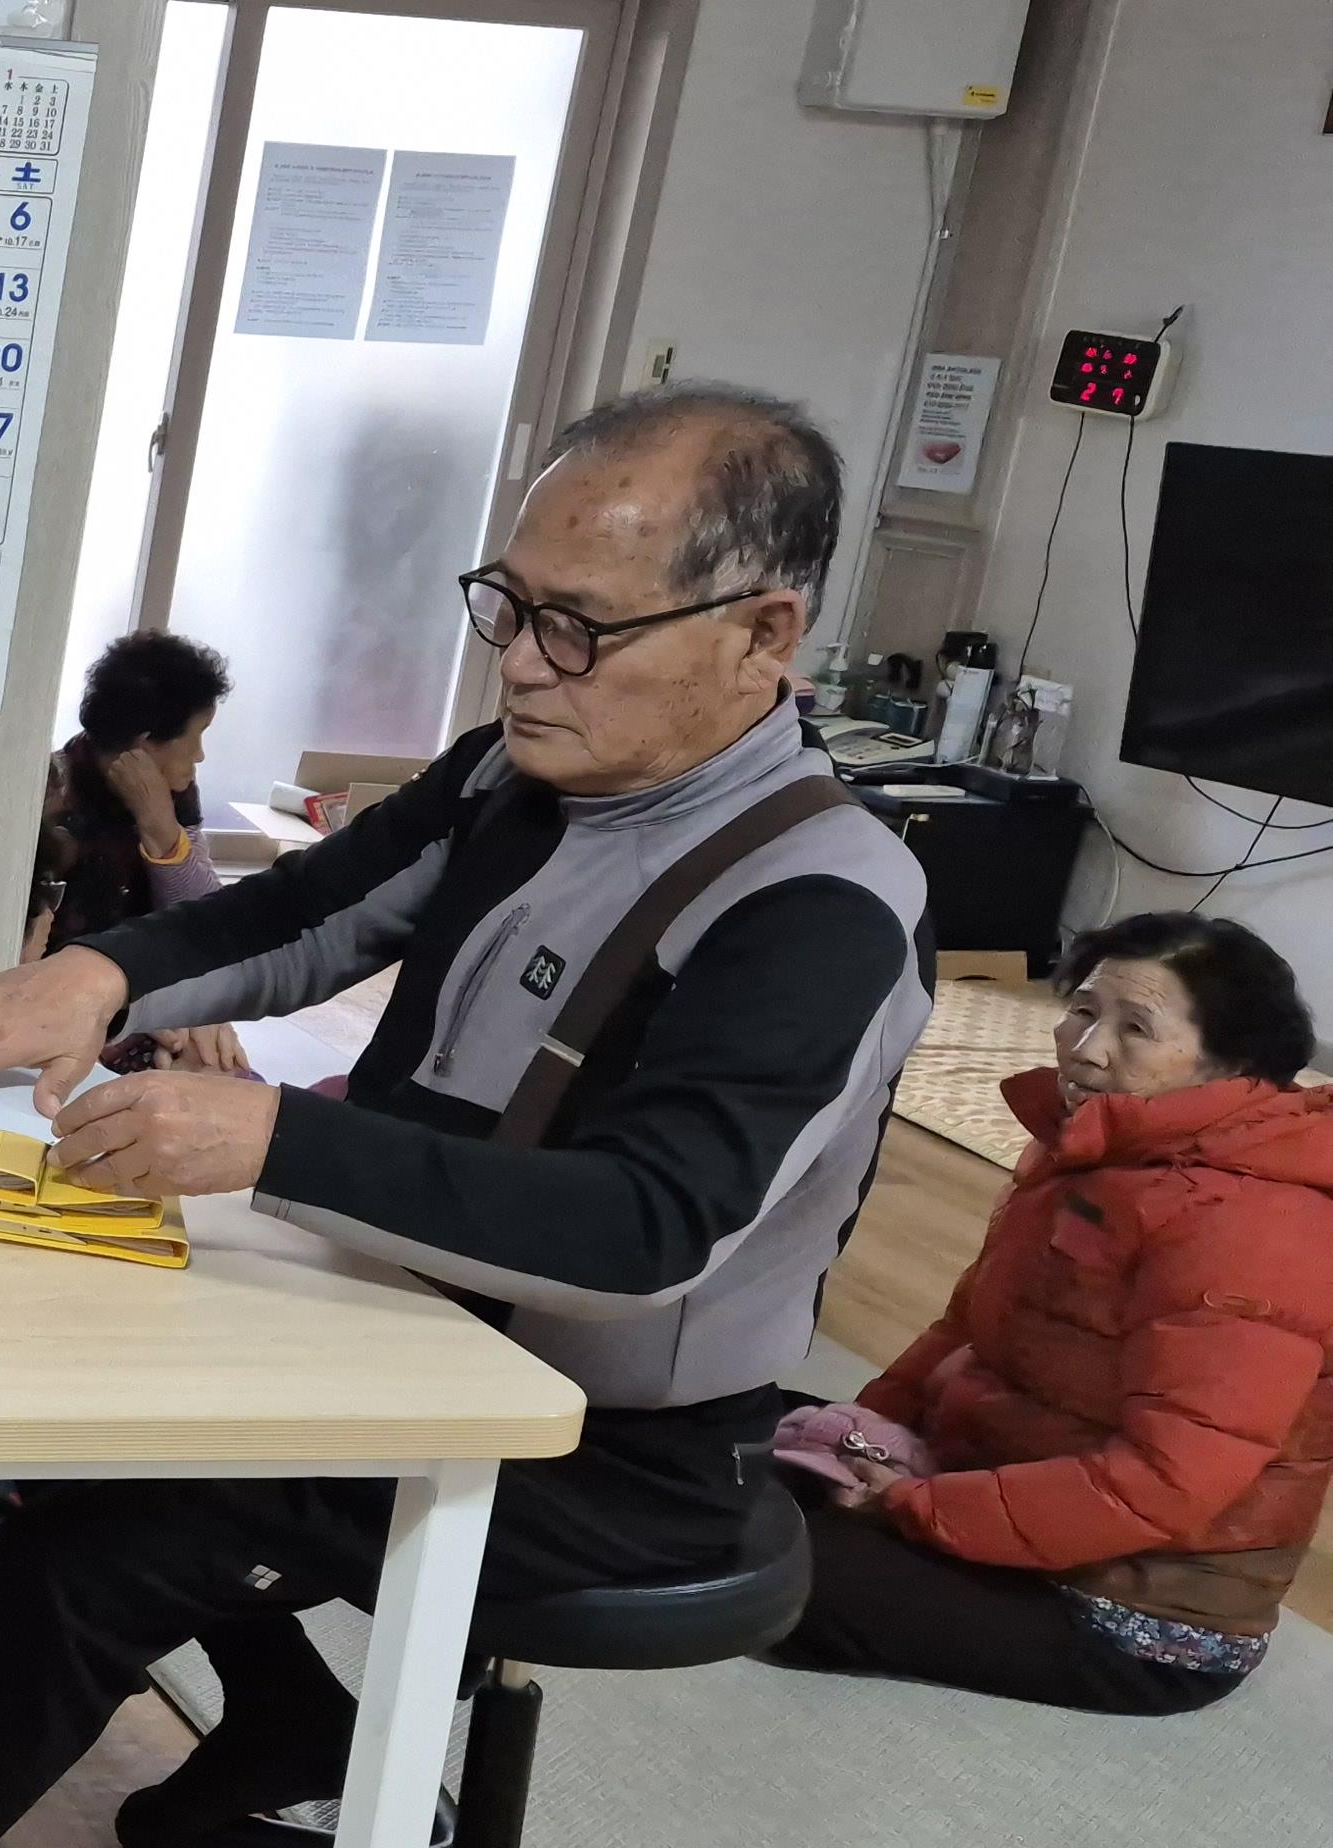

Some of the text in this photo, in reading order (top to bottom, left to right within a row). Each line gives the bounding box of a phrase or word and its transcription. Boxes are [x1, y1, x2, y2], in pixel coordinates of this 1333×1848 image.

[7, 69, 13, 80] 1
[49, 97, 56, 106] 3
[3, 105, 8, 114] 7
[17, 106, 23, 115] 8
[33, 107, 38, 116] 9
[46, 108, 57, 117] 10
[13, 117, 24, 127] 15
[29, 119, 39, 128] 16
[45, 120, 54, 129] 17
[11, 129, 22, 138] 22
[27, 130, 38, 139] 23
[42, 131, 53, 140] 24
[10, 140, 21, 149] 29
[25, 141, 36, 150] 30
[40, 142, 51, 151] 31
[12, 162, 41, 183] 土
[17, 182, 34, 190] SAT
[10, 202, 31, 231] 6
